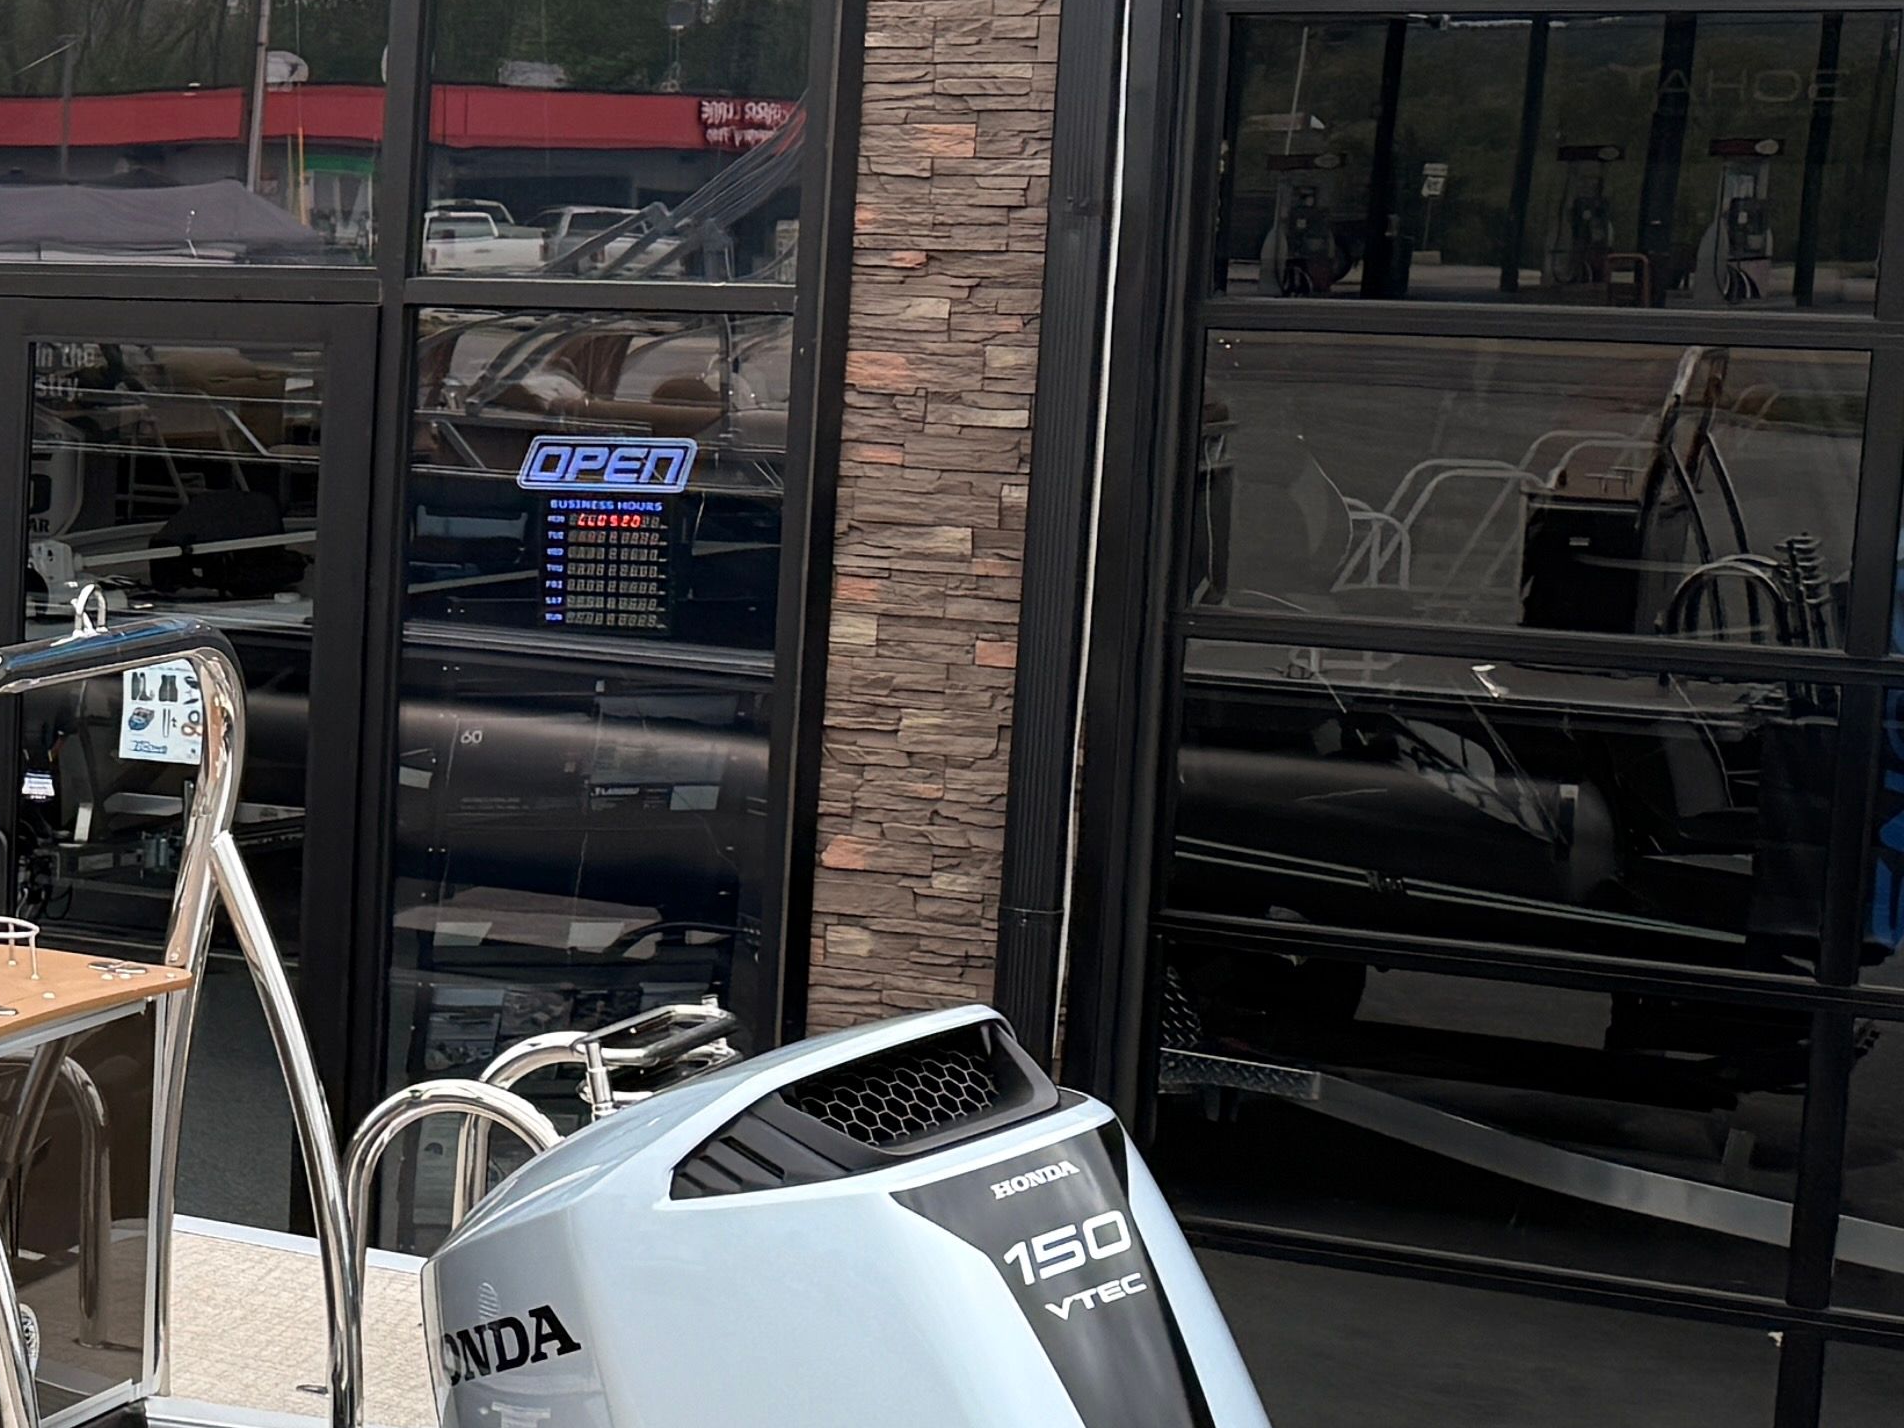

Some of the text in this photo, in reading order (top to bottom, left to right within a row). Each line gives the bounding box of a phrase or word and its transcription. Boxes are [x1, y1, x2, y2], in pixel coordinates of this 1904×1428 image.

[1607, 62, 1851, 103] TAHOE
[61, 342, 96, 368] the
[35, 373, 82, 402] stry.
[527, 445, 686, 484] OPEN
[550, 498, 664, 512] BUSINESS HOURS
[990, 1160, 1080, 1200] HONDA
[1003, 1209, 1132, 1286] 150
[1044, 1272, 1147, 1321] VTEC
[442, 1304, 582, 1387] ONDA
